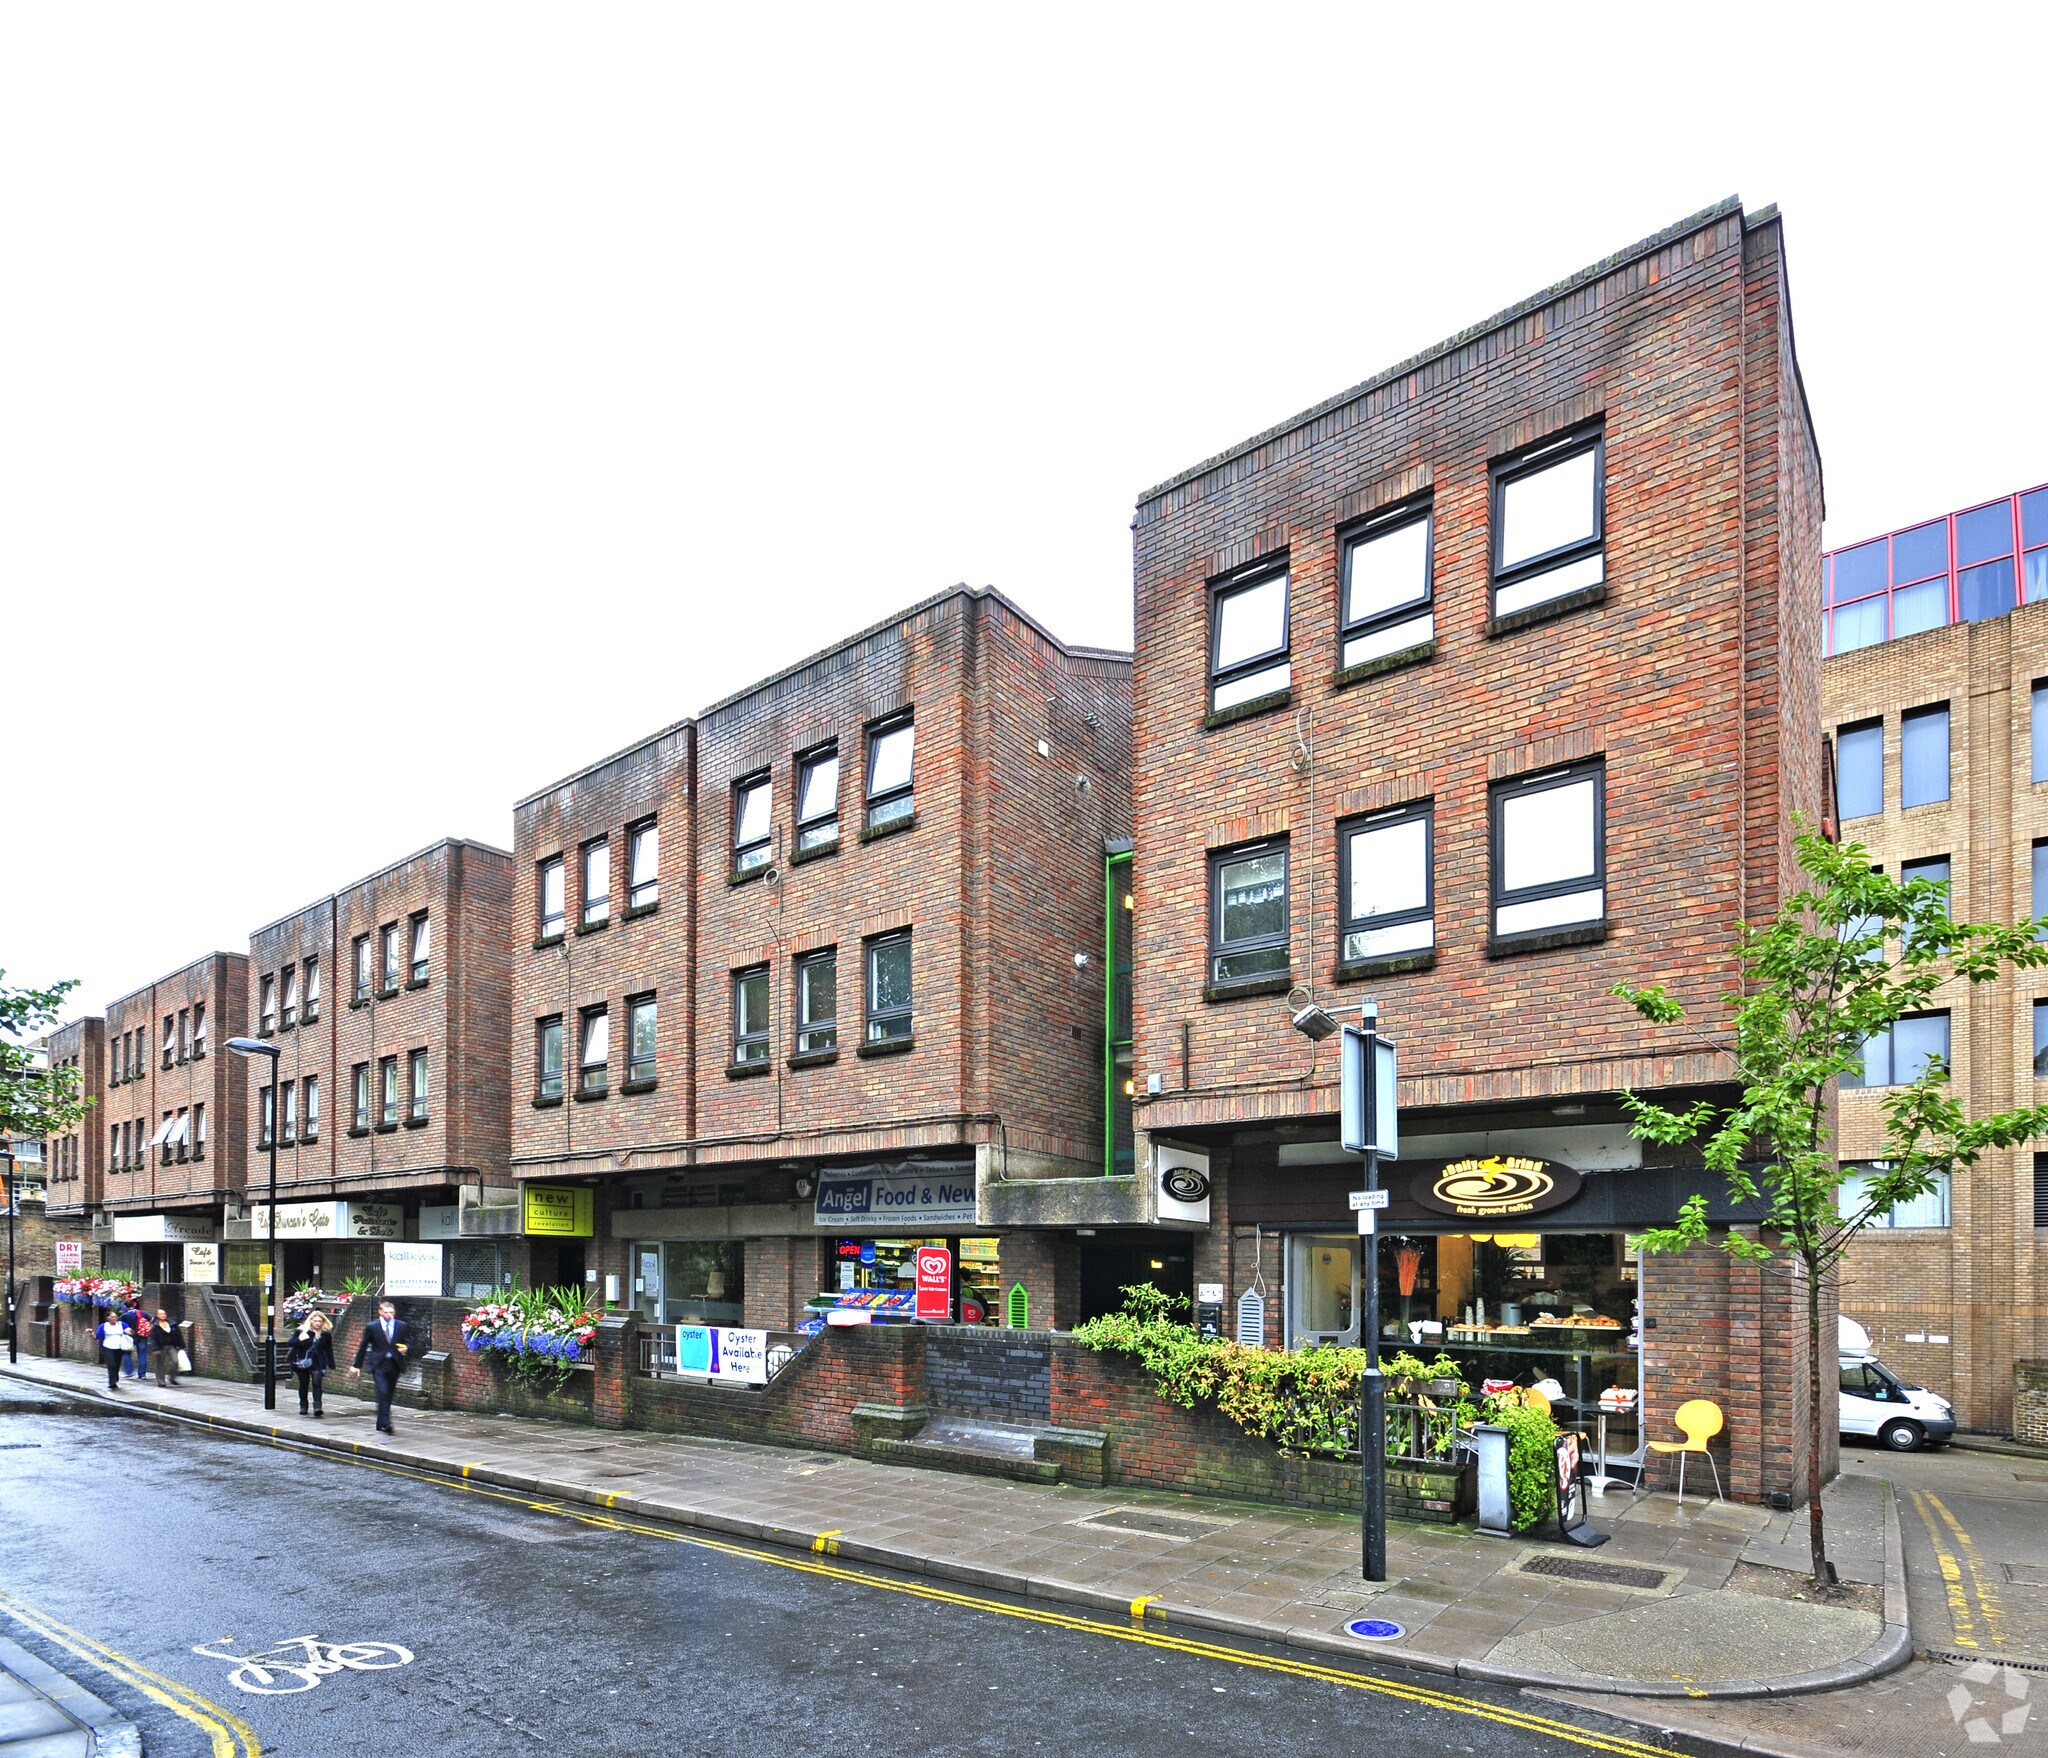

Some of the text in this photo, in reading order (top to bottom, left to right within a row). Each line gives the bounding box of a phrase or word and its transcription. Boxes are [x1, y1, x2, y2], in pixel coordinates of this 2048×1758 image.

[1446, 1160, 1478, 1175] Daily
[1506, 1157, 1544, 1172] Grind
[535, 1193, 568, 1204] new
[822, 1187, 867, 1211] Angel
[876, 1185, 916, 1205] Food
[921, 1188, 932, 1205] &
[533, 1209, 569, 1217] culture
[1456, 1203, 1534, 1216] fresh ground coffee
[165, 1222, 213, 1235] Arcade
[59, 1243, 79, 1252] DRY
[839, 1245, 861, 1255] OPEN
[921, 1274, 946, 1284] WALL'S
[682, 1330, 703, 1340] oyster
[728, 1332, 757, 1345] Oyster
[731, 1361, 751, 1373] Here
